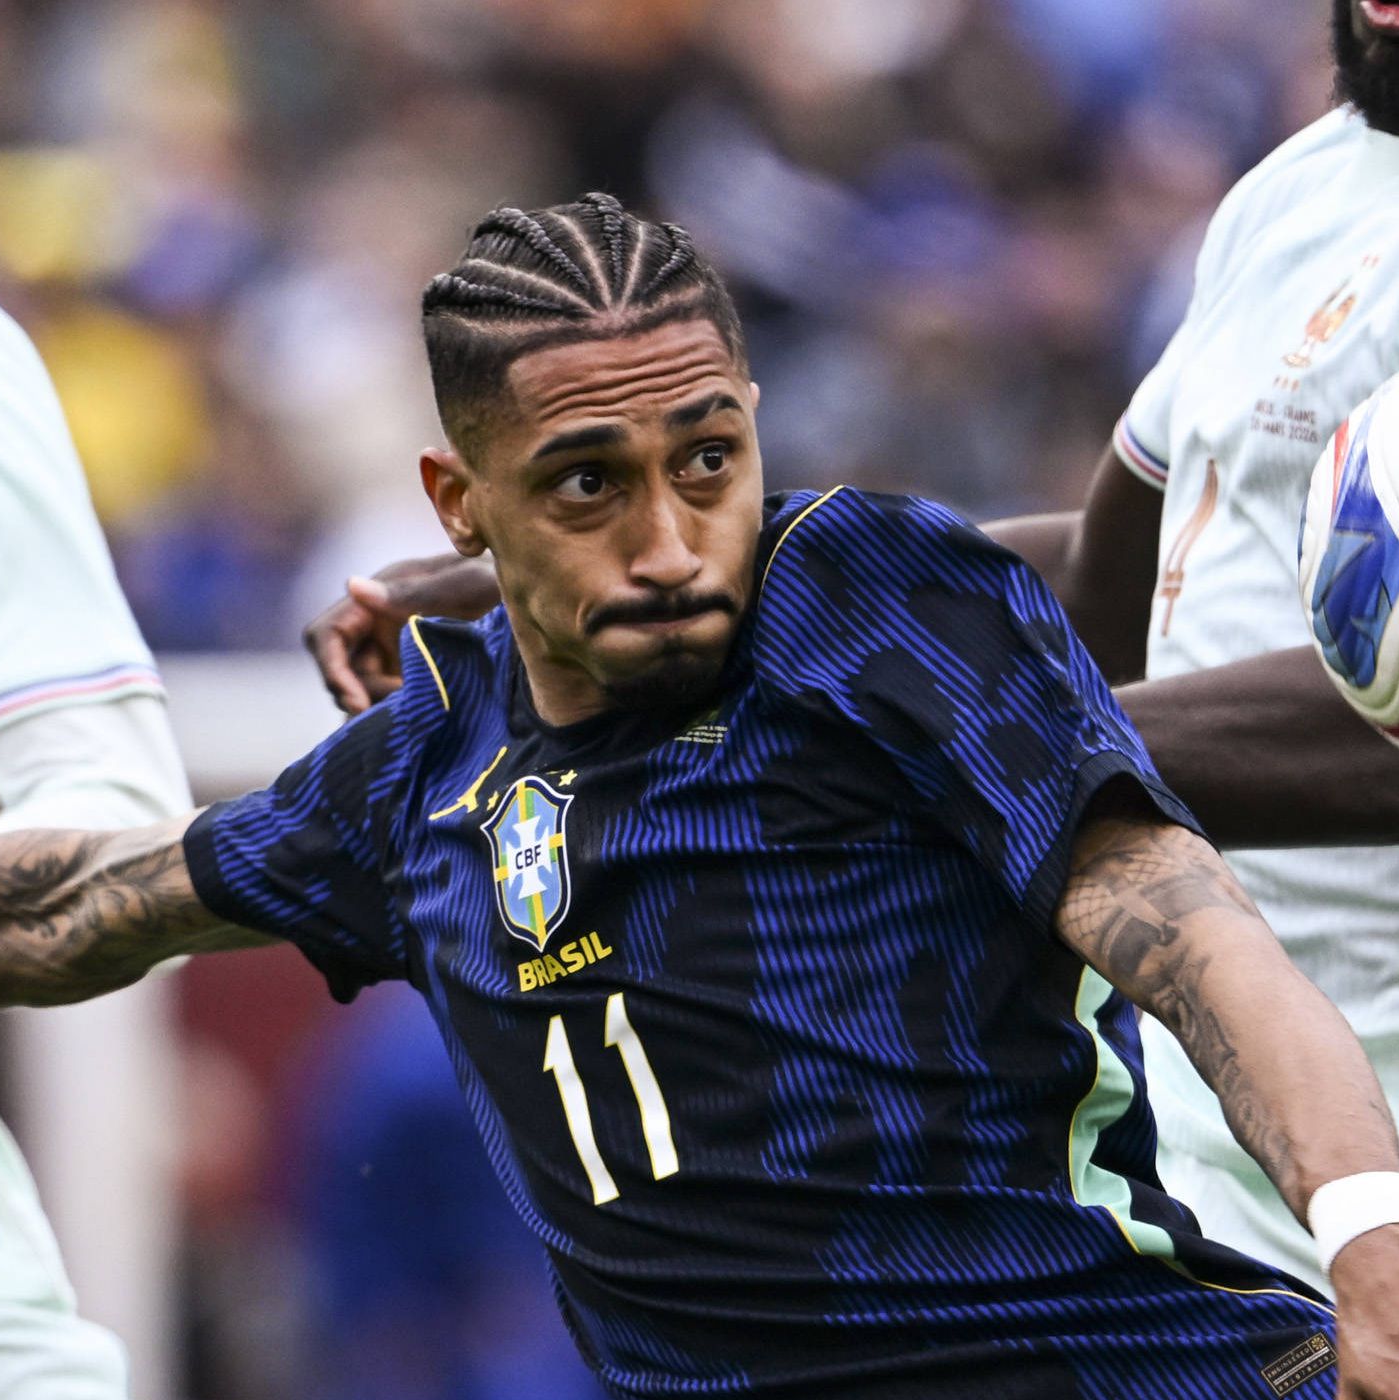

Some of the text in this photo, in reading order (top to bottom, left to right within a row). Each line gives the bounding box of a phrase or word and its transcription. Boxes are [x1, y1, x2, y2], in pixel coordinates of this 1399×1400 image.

[514, 843, 543, 872] CBF
[517, 930, 613, 993] BRASIL
[543, 991, 680, 1207] 11
